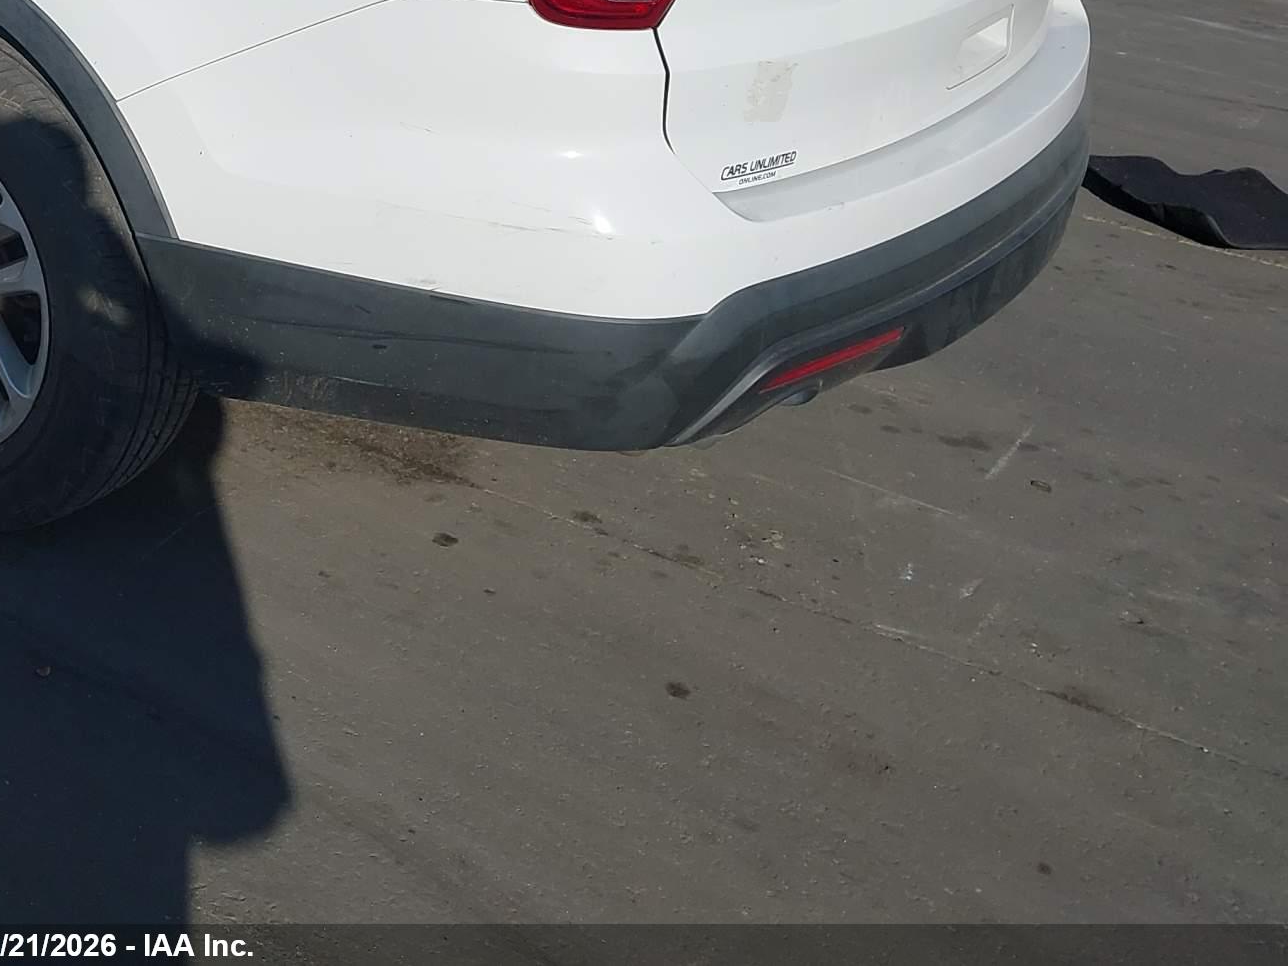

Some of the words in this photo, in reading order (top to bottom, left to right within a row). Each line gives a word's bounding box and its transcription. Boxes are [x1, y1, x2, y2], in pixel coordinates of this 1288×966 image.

[721, 162, 749, 181] CARS
[750, 151, 797, 172] UNLIMITED
[738, 171, 777, 185] ONLINE.COM
